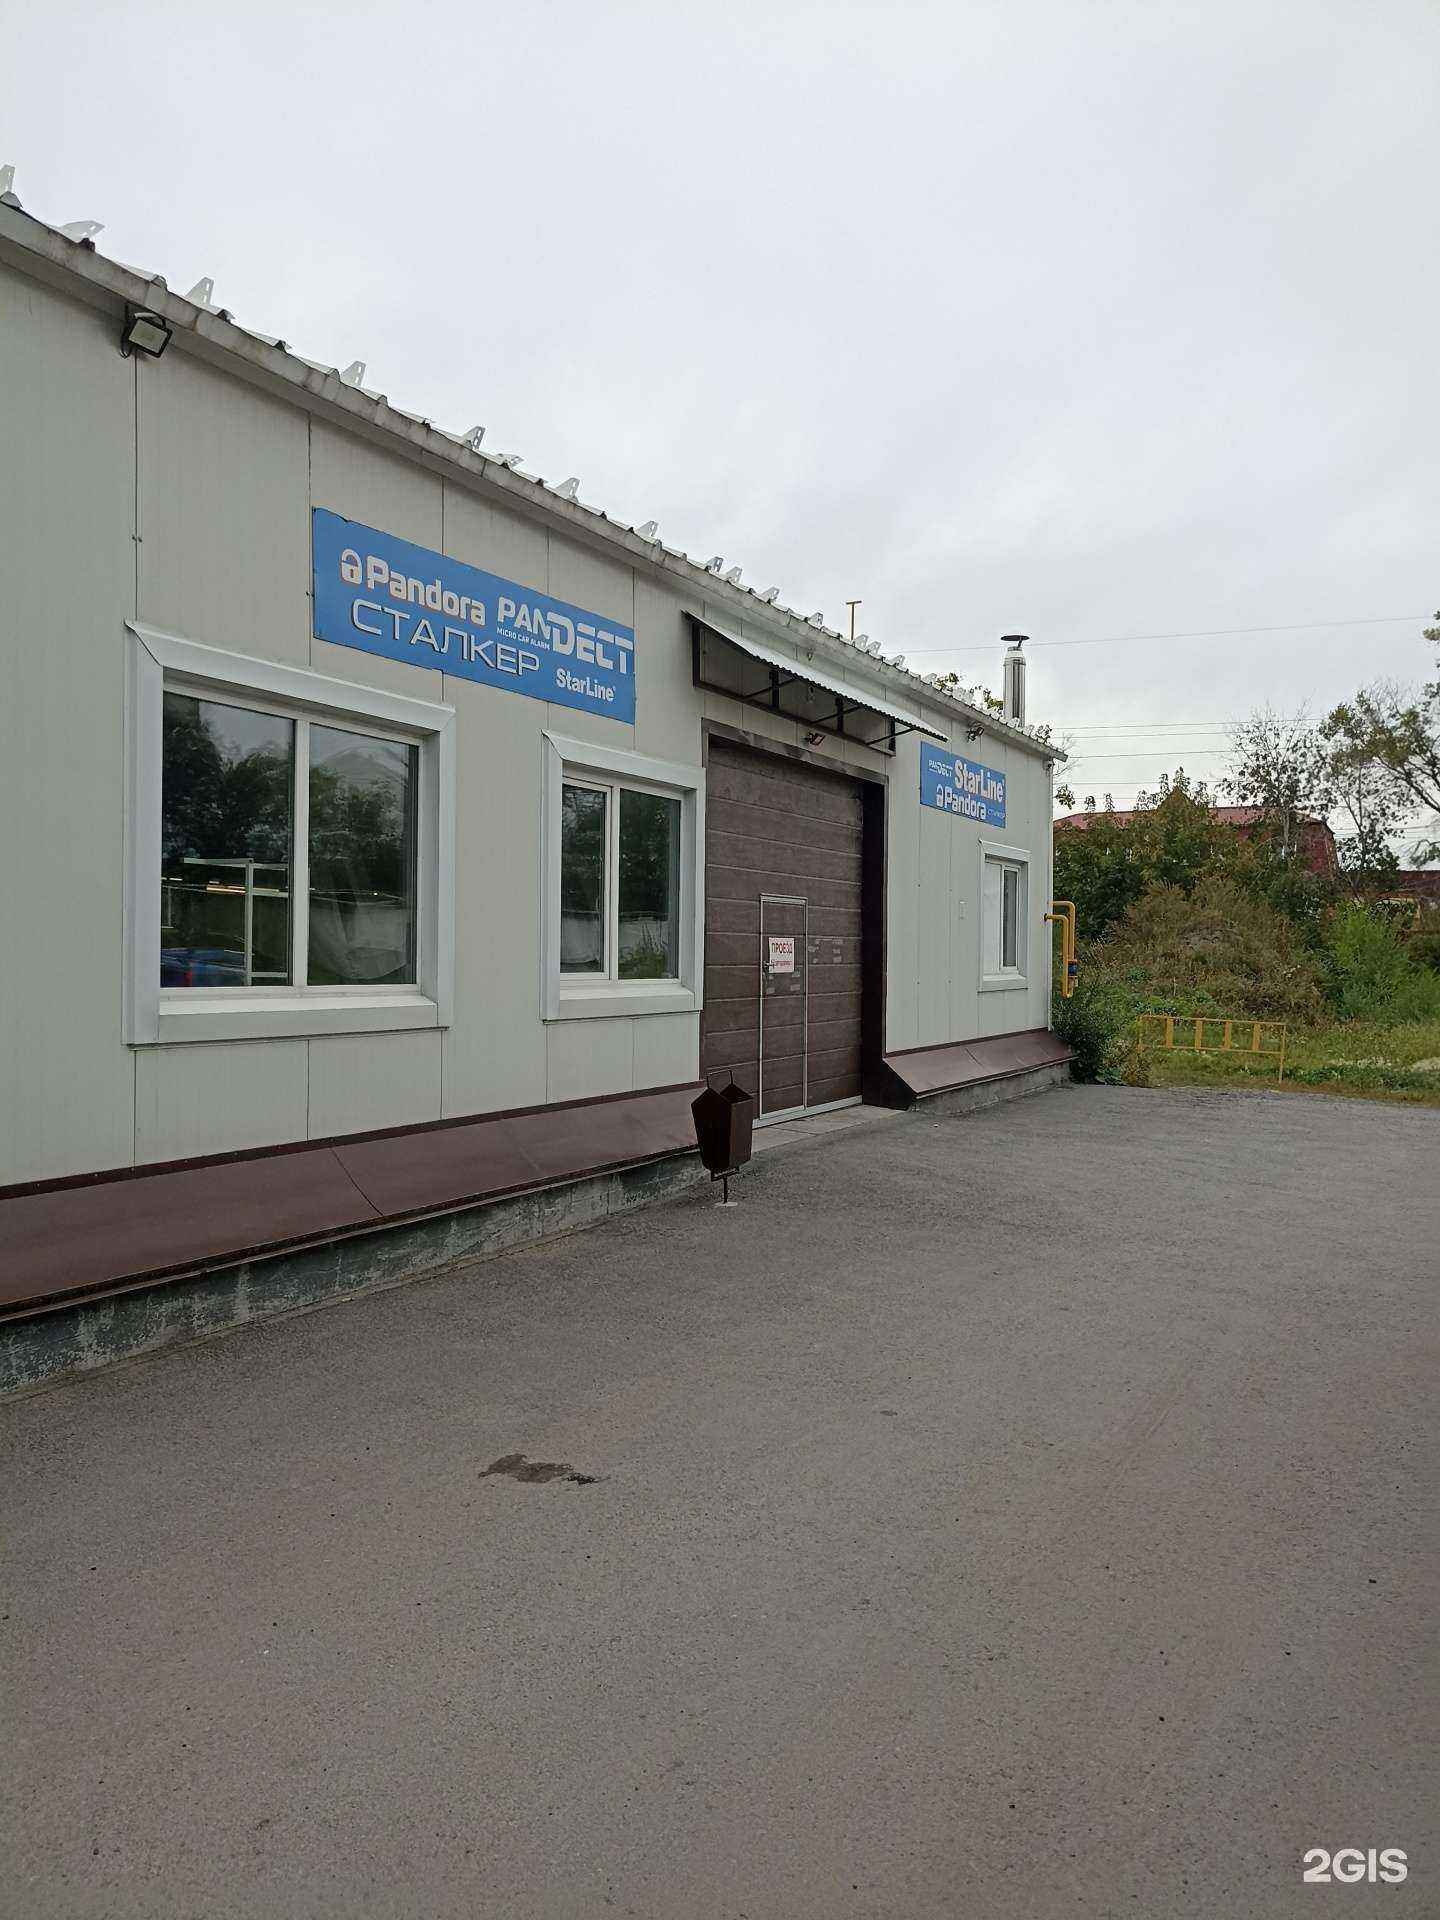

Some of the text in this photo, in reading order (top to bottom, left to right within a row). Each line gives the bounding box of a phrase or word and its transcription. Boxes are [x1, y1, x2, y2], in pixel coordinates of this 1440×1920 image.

[366, 555, 486, 626] Pandora
[352, 598, 541, 676] СТАЛКЕР
[496, 627, 551, 651] MICRO CAR ALARM
[497, 596, 634, 674] PANDECT
[555, 668, 614, 702] StarLine
[954, 760, 1004, 802] StarLine
[944, 786, 986, 819] Pandora
